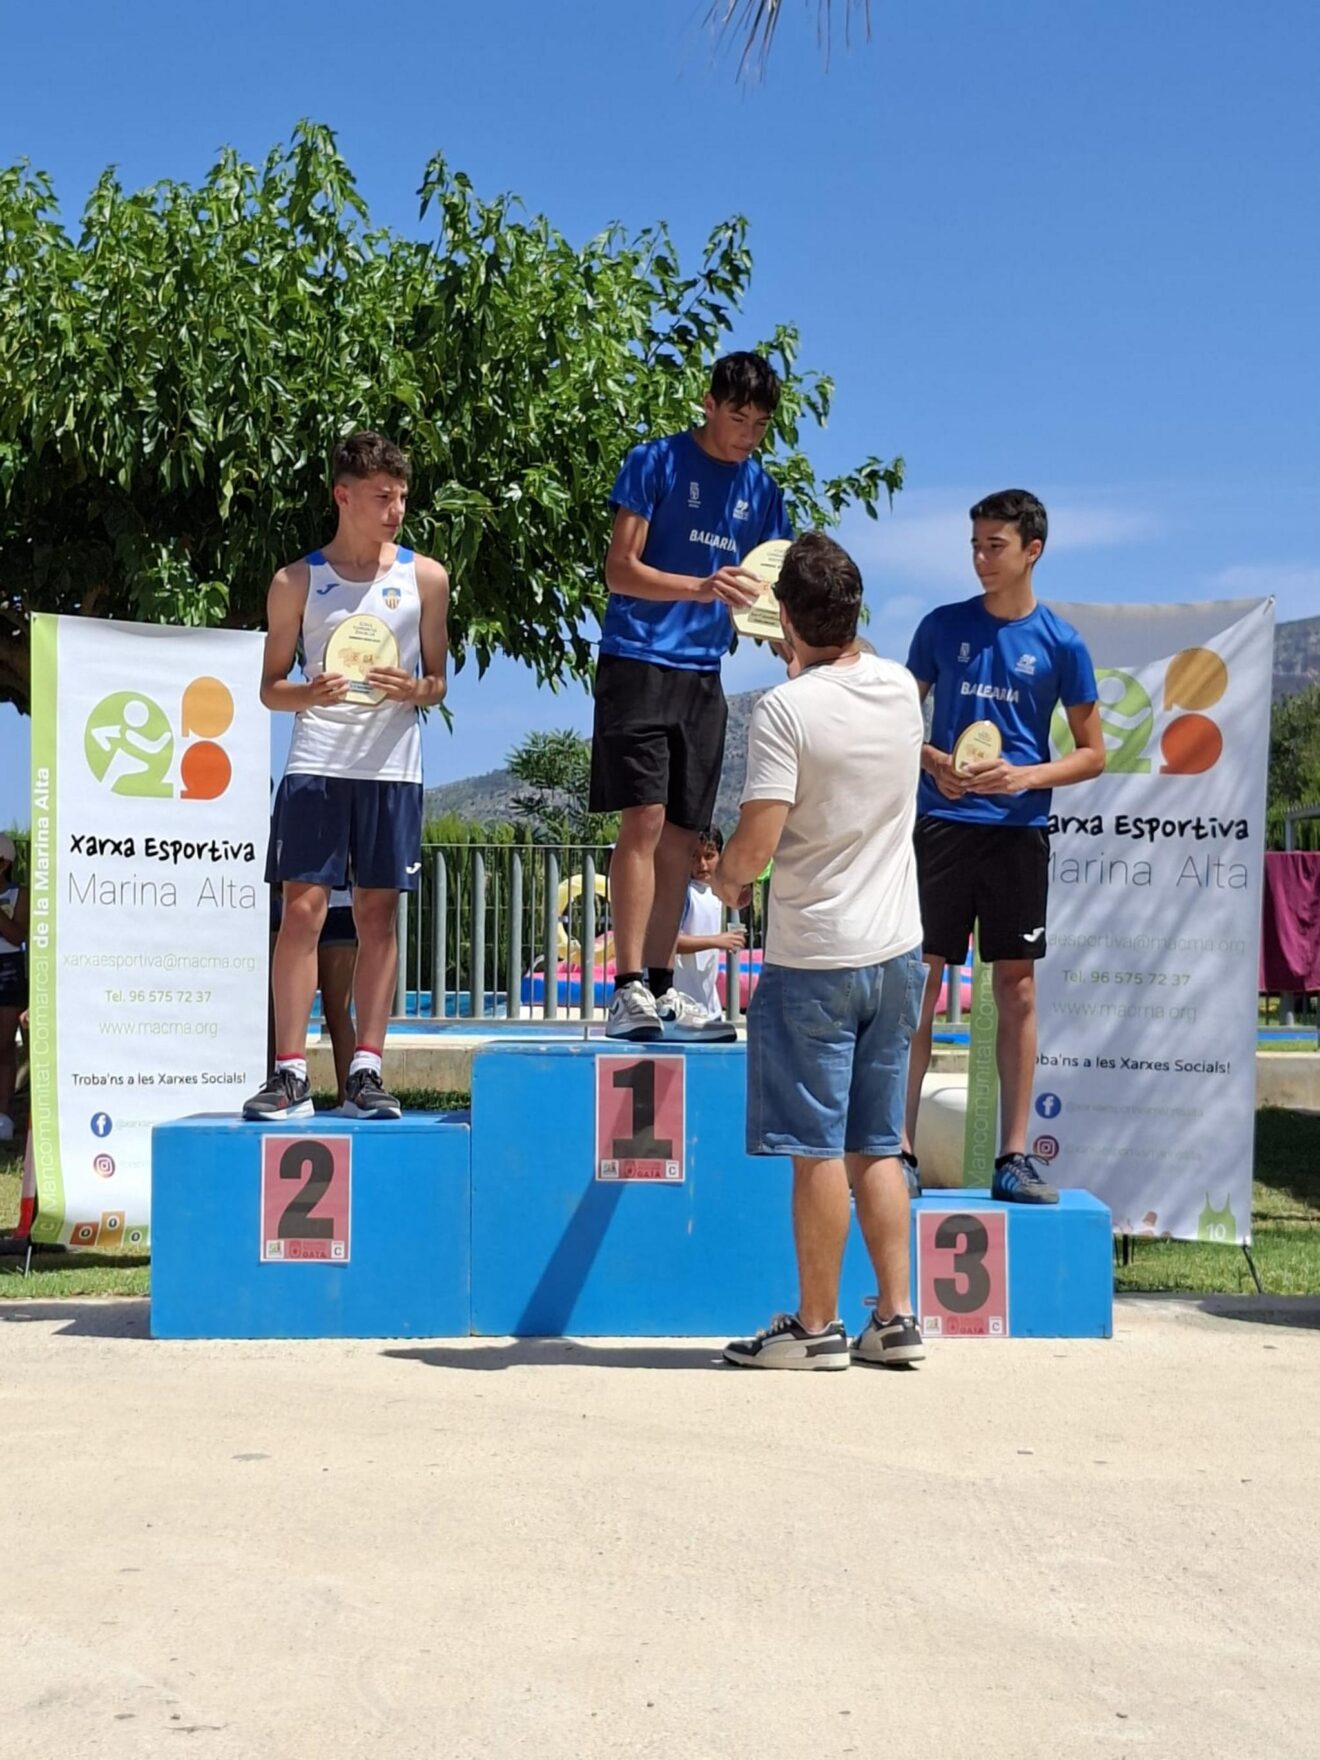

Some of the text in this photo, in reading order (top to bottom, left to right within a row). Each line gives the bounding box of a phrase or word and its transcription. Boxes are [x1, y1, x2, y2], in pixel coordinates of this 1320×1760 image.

[1047, 814, 1249, 843] arxa Esportiva
[144, 837, 256, 865] Esportiva
[1176, 854, 1248, 889] Alta
[68, 871, 256, 909] Marina Alta
[63, 952, 256, 971] xarxaesportiva@macma.org
[33, 767, 57, 1212] Mancomunitat Comarcal de la Marina Alta
[1062, 969, 1191, 987] Tel. 96 575 72 37
[105, 990, 212, 1003] Tel. 96 575 72 37
[99, 1020, 219, 1038] www.macma.org
[71, 1072, 247, 1086] Troba'ns a les Xarxes Socials!
[1083, 1057, 1092, 1068] a
[1095, 1056, 1116, 1069] les
[1119, 1057, 1171, 1071] Xarxes
[1174, 1059, 1231, 1074] Socials!
[612, 1060, 673, 1159] 1
[277, 1139, 335, 1239] 2
[1206, 1223, 1226, 1241] 10
[933, 1213, 991, 1314] 3
